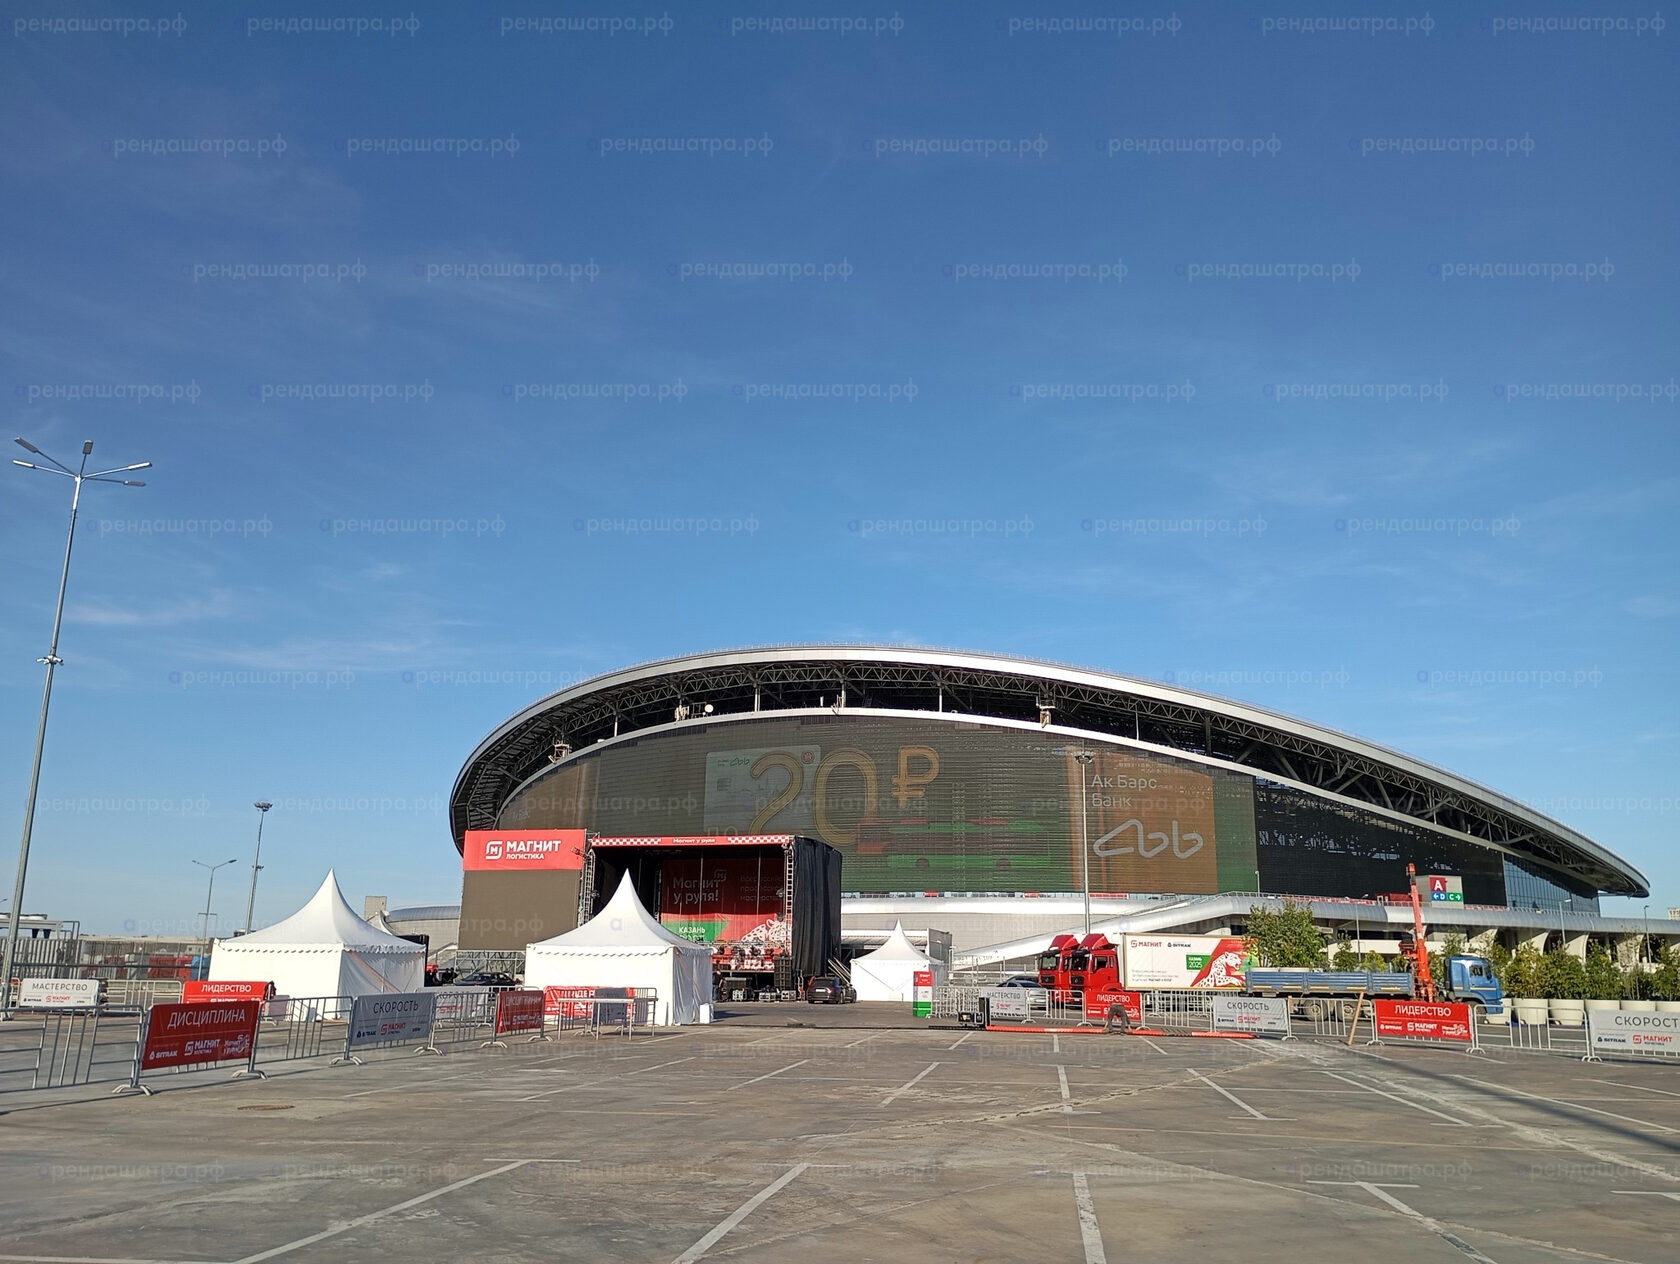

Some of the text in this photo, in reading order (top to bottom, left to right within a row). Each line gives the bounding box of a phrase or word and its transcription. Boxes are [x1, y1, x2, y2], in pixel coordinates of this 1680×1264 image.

[1091, 774, 1157, 791] Ак Барс
[1091, 793, 1132, 807] Банк
[506, 840, 561, 852] МАГНИТ
[673, 878, 719, 888] Магнит
[1434, 880, 1443, 890] A
[679, 926, 706, 934] КАЗАНЬ
[32, 983, 88, 991] МАСТЕРСТВО
[202, 984, 252, 993] ЛИДЕРСТВО
[1096, 994, 1130, 1002] ЛИДЕРСТВО
[373, 1000, 419, 1014] СКОРОСТЬ
[1227, 1002, 1270, 1010] СКОРОСТЬ
[1395, 1005, 1451, 1016] ЛИДЕРСТВО
[167, 1009, 246, 1030] ДИСЦИПЛИНА
[1615, 1016, 1679, 1028] СКОРОСТ
[194, 1039, 221, 1049] МАГНИТ
